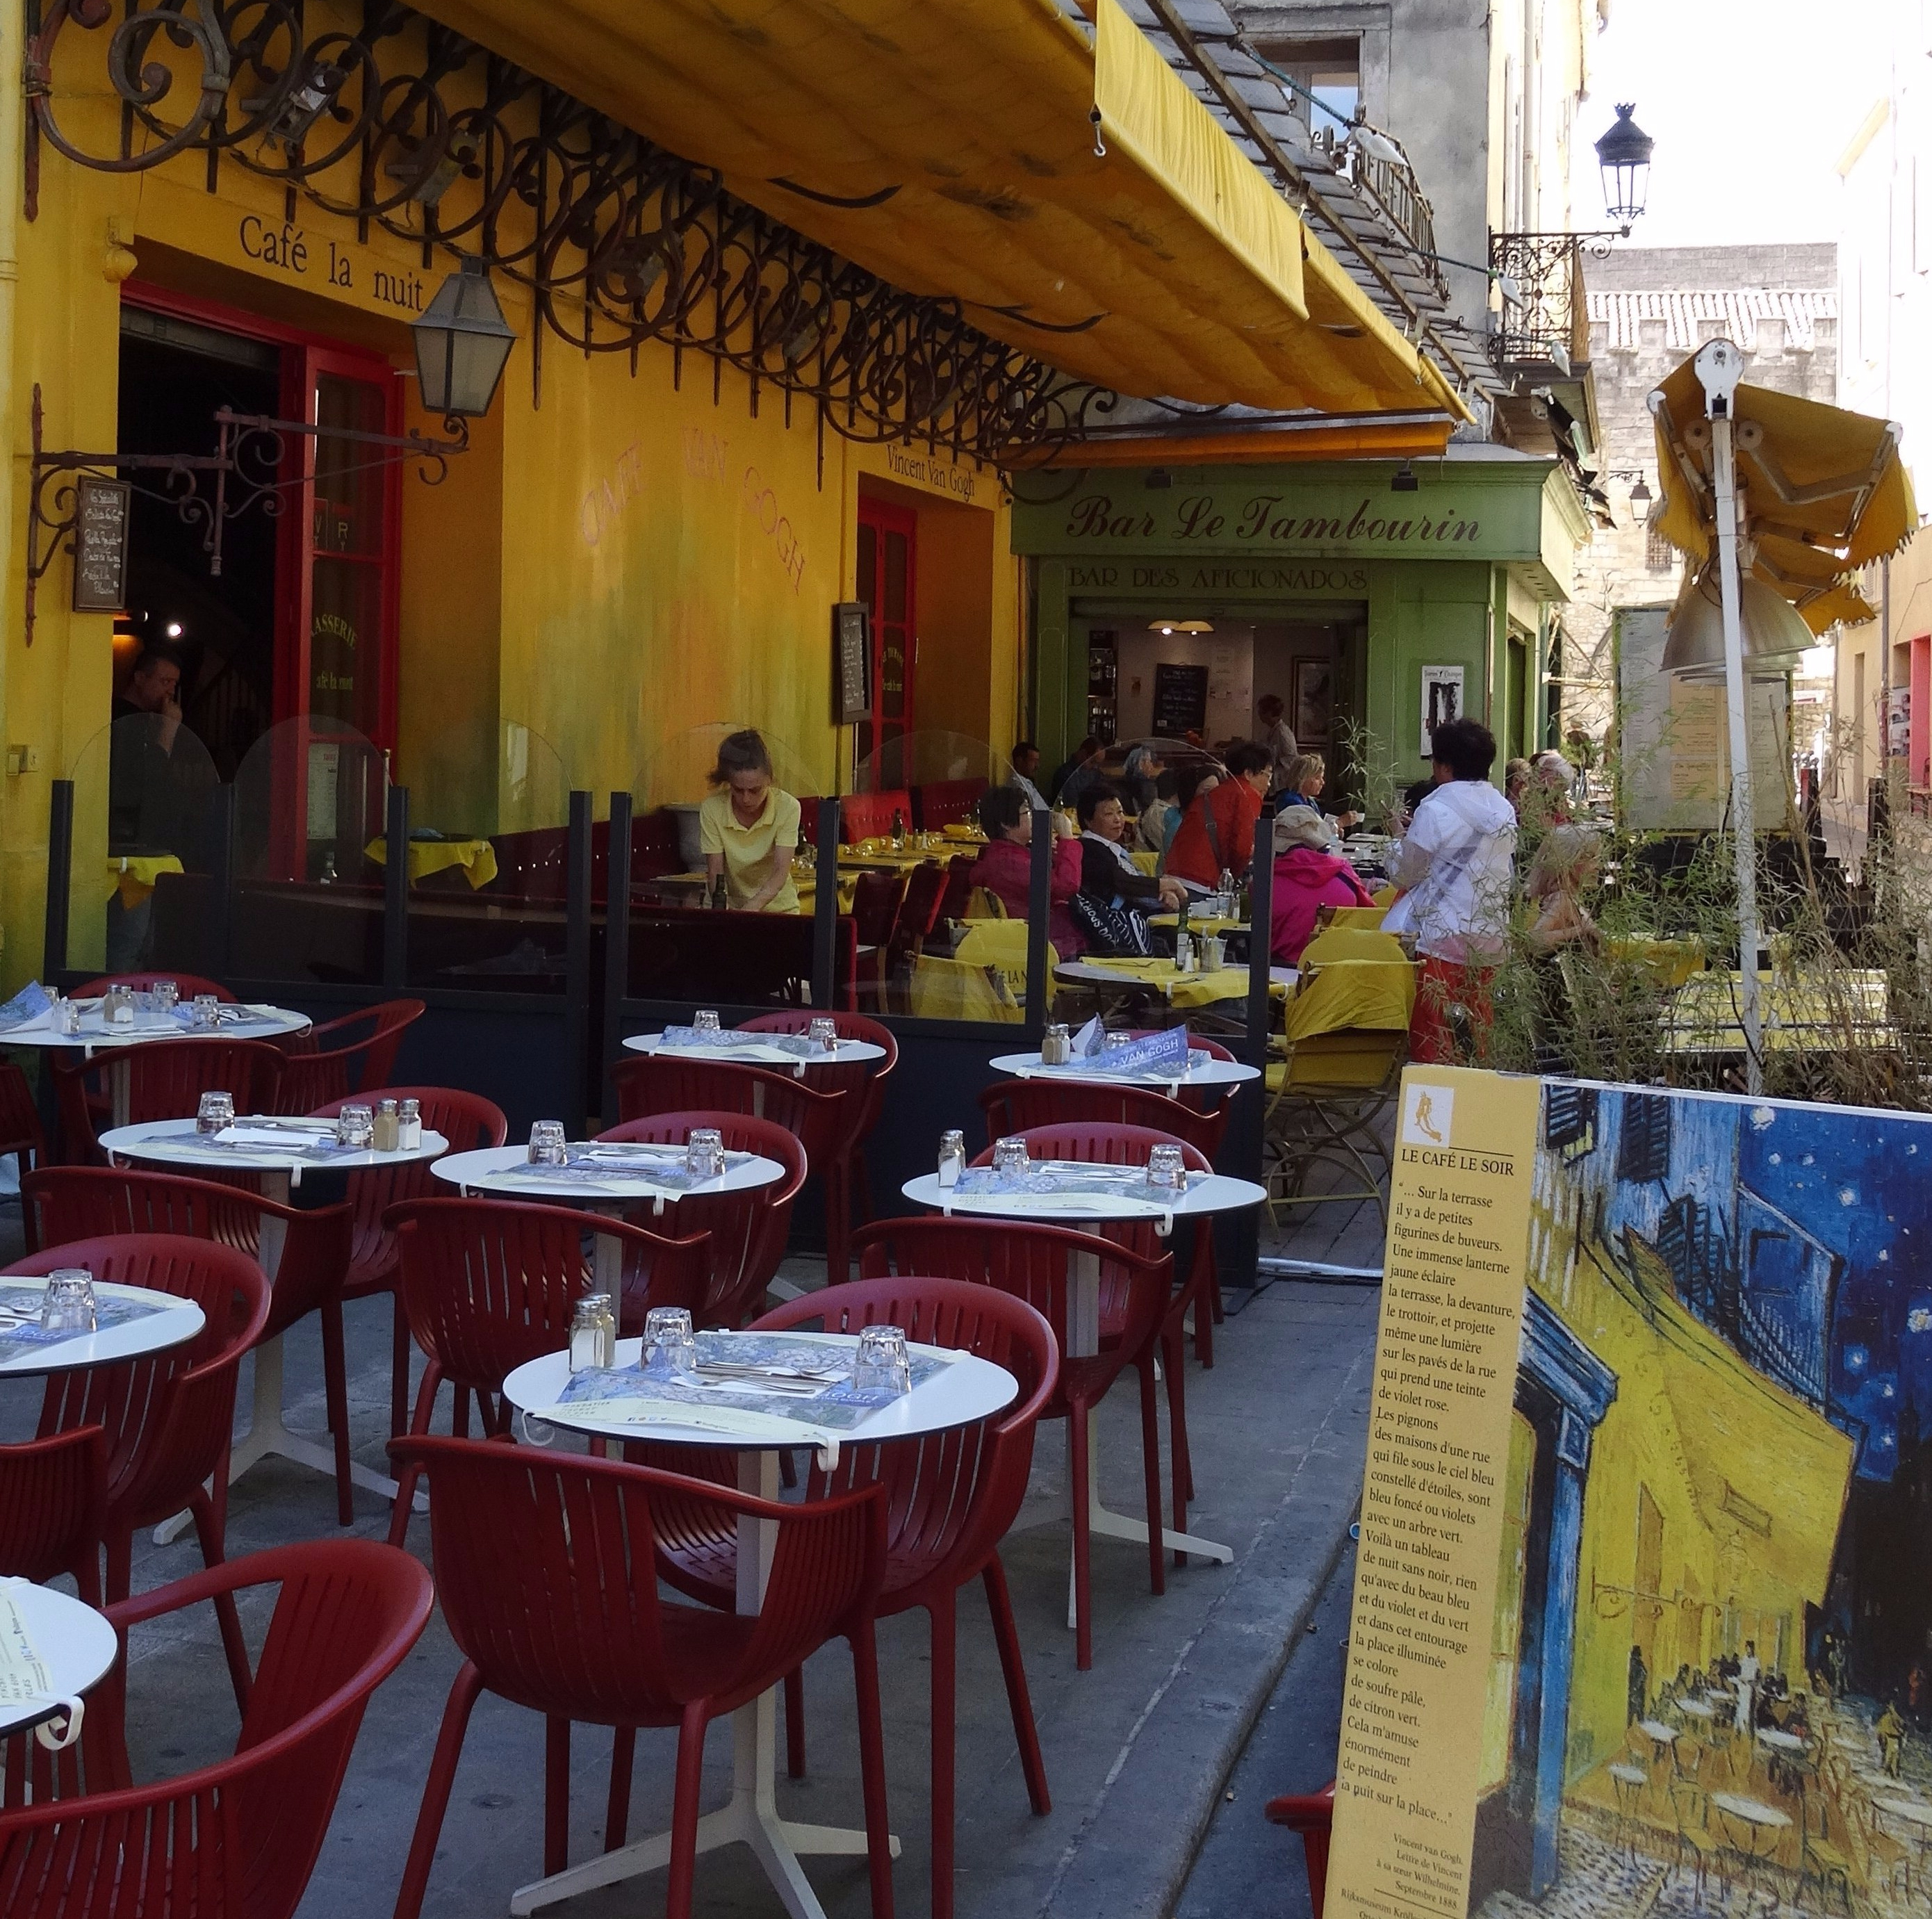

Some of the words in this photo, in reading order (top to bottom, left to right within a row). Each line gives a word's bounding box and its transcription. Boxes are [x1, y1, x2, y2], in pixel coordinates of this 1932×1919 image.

[240, 215, 307, 273] Café
[328, 241, 352, 288] la
[373, 270, 423, 312] nuit
[886, 444, 925, 482] Vincent
[928, 459, 946, 488] Van
[949, 467, 975, 503] Gogh
[1066, 496, 1157, 538] Bar
[1170, 496, 1225, 539] Le
[1236, 496, 1482, 541] Tambourin
[1068, 568, 1118, 587] BAR
[1133, 568, 1179, 587] DES
[1191, 569, 1368, 589] AFICIONADOS
[311, 614, 358, 650] ASSERIE
[1121, 1050, 1144, 1064] VAN
[1147, 1038, 1179, 1057] GOGH
[1401, 1147, 1419, 1163] LE
[1422, 1149, 1456, 1168] CAFÉ
[1459, 1157, 1477, 1170] LE
[1481, 1159, 1514, 1176] SOIR
[1418, 1186, 1437, 1200] Sur
[1439, 1188, 1448, 1201] la
[1452, 1192, 1493, 1208] terrasse
[1395, 1202, 1403, 1216] il
[1405, 1208, 1412, 1219] y
[1414, 1209, 1421, 1218] a
[1423, 1207, 1436, 1220] de
[1438, 1213, 1473, 1226] petites
[1394, 1222, 1439, 1241] figurines
[1442, 1230, 1457, 1244] de
[1458, 1232, 1502, 1251] buveurs.
[1393, 1243, 1413, 1258] Une
[1416, 1247, 1463, 1268] immense
[1466, 1255, 1509, 1274] lanterne
[1390, 1264, 1418, 1280] jaune
[1421, 1270, 1456, 1286] éclaire
[1389, 1283, 1397, 1297] la
[1401, 1289, 1443, 1306] terrasse,
[1447, 1293, 1456, 1307] la
[1459, 1296, 1515, 1319] devanture,
[1386, 1303, 1395, 1317] le
[1398, 1307, 1438, 1327] trottoir,
[1441, 1317, 1451, 1328] et
[1454, 1319, 1496, 1335] projette
[1385, 1327, 1418, 1341] même
[1419, 1334, 1439, 1346] une
[1441, 1334, 1482, 1354] lumière
[1383, 1348, 1400, 1359] sur
[1402, 1348, 1416, 1364] les
[1418, 1355, 1447, 1369] pavés
[1450, 1358, 1462, 1372] de
[1466, 1360, 1475, 1374] la
[1478, 1367, 1496, 1378] rue
[1380, 1368, 1398, 1381] qui
[1400, 1373, 1430, 1387] prend
[1433, 1379, 1453, 1391] une
[1456, 1382, 1486, 1398] teinte
[1379, 1386, 1391, 1400] de
[1394, 1390, 1421, 1406] violet
[1425, 1398, 1449, 1412] rose.
[1377, 1406, 1394, 1421] Les
[1398, 1412, 1438, 1430] pignons
[1375, 1426, 1392, 1442] des
[1395, 1435, 1437, 1451] maisons
[1440, 1441, 1469, 1459] d'une
[1472, 1451, 1491, 1464] rue
[1373, 1450, 1391, 1463] qui
[1393, 1451, 1409, 1467] file
[1411, 1460, 1434, 1472] sous
[1437, 1461, 1447, 1475] le
[1450, 1466, 1468, 1480] ciel
[1471, 1468, 1493, 1486] bleu
[1371, 1471, 1416, 1489] constellé
[1418, 1478, 1464, 1503] d'étoiles,
[1468, 1494, 1490, 1507] sont
[1370, 1487, 1391, 1505] bleu
[1394, 1494, 1422, 1512] foncé
[1425, 1505, 1438, 1517] ou
[1441, 1507, 1475, 1525] violets
[1367, 1512, 1390, 1525] avec
[1393, 1518, 1405, 1529] un
[1409, 1520, 1437, 1537] arbre
[1439, 1530, 1462, 1543] vert.
[1366, 1529, 1391, 1547] Voilà
[1395, 1540, 1408, 1551] un
[1412, 1542, 1450, 1562] tableau
[1364, 1550, 1375, 1564] de
[1378, 1557, 1399, 1570] nuit
[1402, 1563, 1425, 1576] sans
[1427, 1569, 1452, 1586] noir,
[1455, 1575, 1477, 1590] rien
[1361, 1574, 1399, 1591] qu'avec
[1402, 1581, 1417, 1596] du
[1418, 1584, 1443, 1603] beau
[1447, 1592, 1469, 1610] bleu
[1359, 1594, 1369, 1604] et
[1371, 1594, 1384, 1609] du
[1387, 1600, 1416, 1617] violet
[1419, 1611, 1428, 1621] et
[1432, 1610, 1445, 1626] du
[1449, 1618, 1468, 1632] vert
[1355, 1631, 1366, 1646] la
[1368, 1636, 1394, 1654] place
[1397, 1644, 1446, 1669] illuminée
[1357, 1615, 1366, 1625] et
[1369, 1615, 1393, 1633] dans
[1397, 1626, 1411, 1638] cet
[1415, 1631, 1468, 1654] entourage
[1354, 1656, 1364, 1667] se
[1366, 1659, 1398, 1677] colore
[1351, 1674, 1364, 1688] de
[1366, 1681, 1398, 1698] soufre
[1401, 1690, 1425, 1708] pâle,
[1350, 1695, 1361, 1708] de
[1364, 1700, 1394, 1720] citron
[1398, 1713, 1420, 1726] vert.
[1348, 1715, 1369, 1733] Cela
[1373, 1726, 1418, 1747] m'amuse
[1345, 1737, 1409, 1767] énormément
[1343, 1757, 1355, 1771] de
[1358, 1765, 1397, 1785] peindre
[1376, 1793, 1394, 1804] sur
[1397, 1795, 1405, 1809] la
